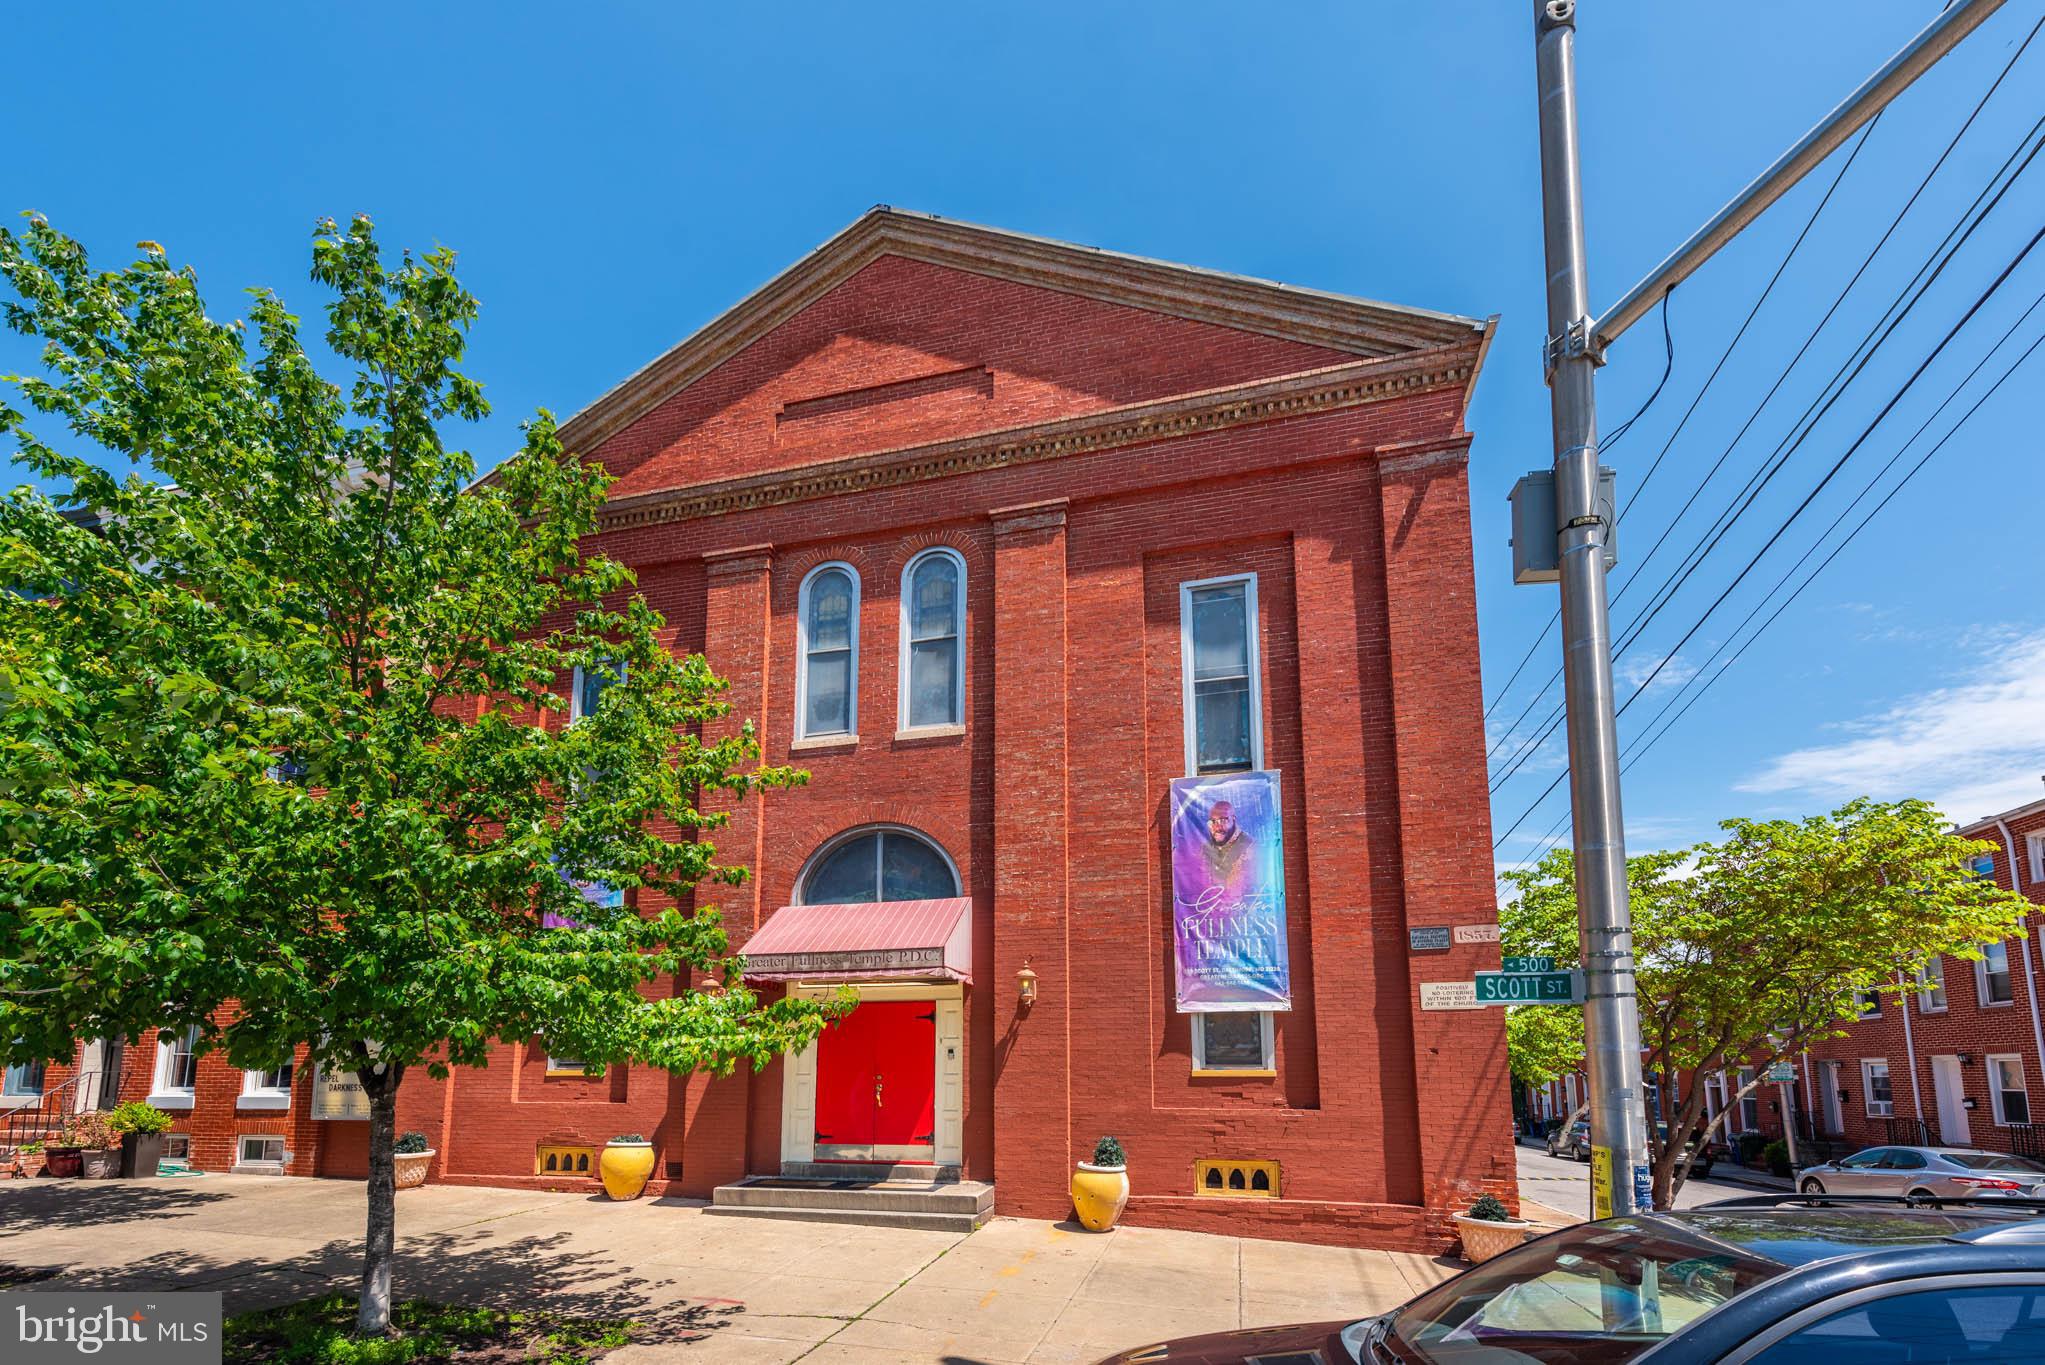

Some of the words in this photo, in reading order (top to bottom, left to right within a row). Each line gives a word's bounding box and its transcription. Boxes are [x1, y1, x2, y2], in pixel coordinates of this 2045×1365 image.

[1183, 916, 1278, 939] FULLNESS
[791, 953, 841, 967] Fullness
[847, 951, 893, 967] Temple
[899, 950, 938, 963] P.D.C.
[1193, 938, 1269, 960] TEMPLE
[1519, 958, 1549, 972] 500
[1485, 977, 1542, 999] SCOTT
[1546, 980, 1568, 994] ST.
[328, 1083, 363, 1092] DARKNESS
